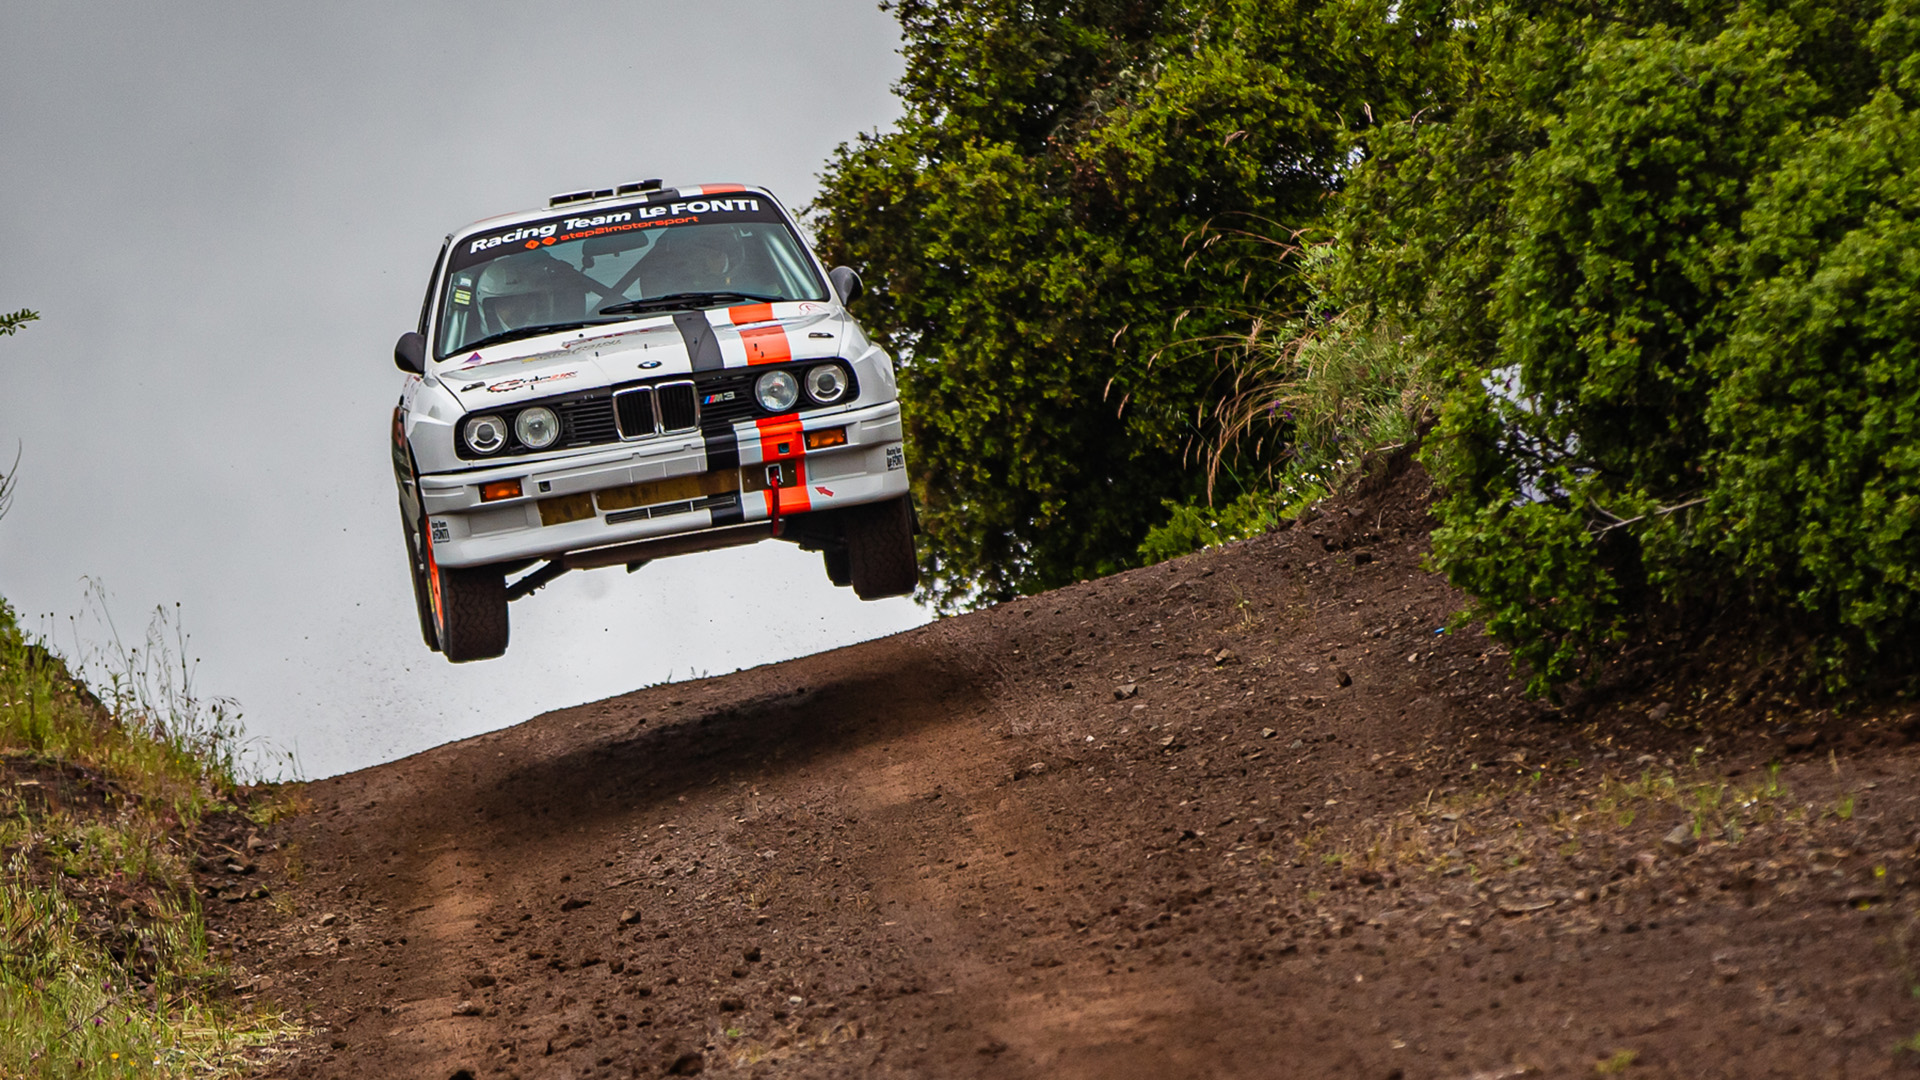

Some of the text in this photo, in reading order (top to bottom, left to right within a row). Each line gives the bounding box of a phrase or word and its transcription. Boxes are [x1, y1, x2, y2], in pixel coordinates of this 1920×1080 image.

[470, 199, 759, 254] Racing Team Le FONTI
